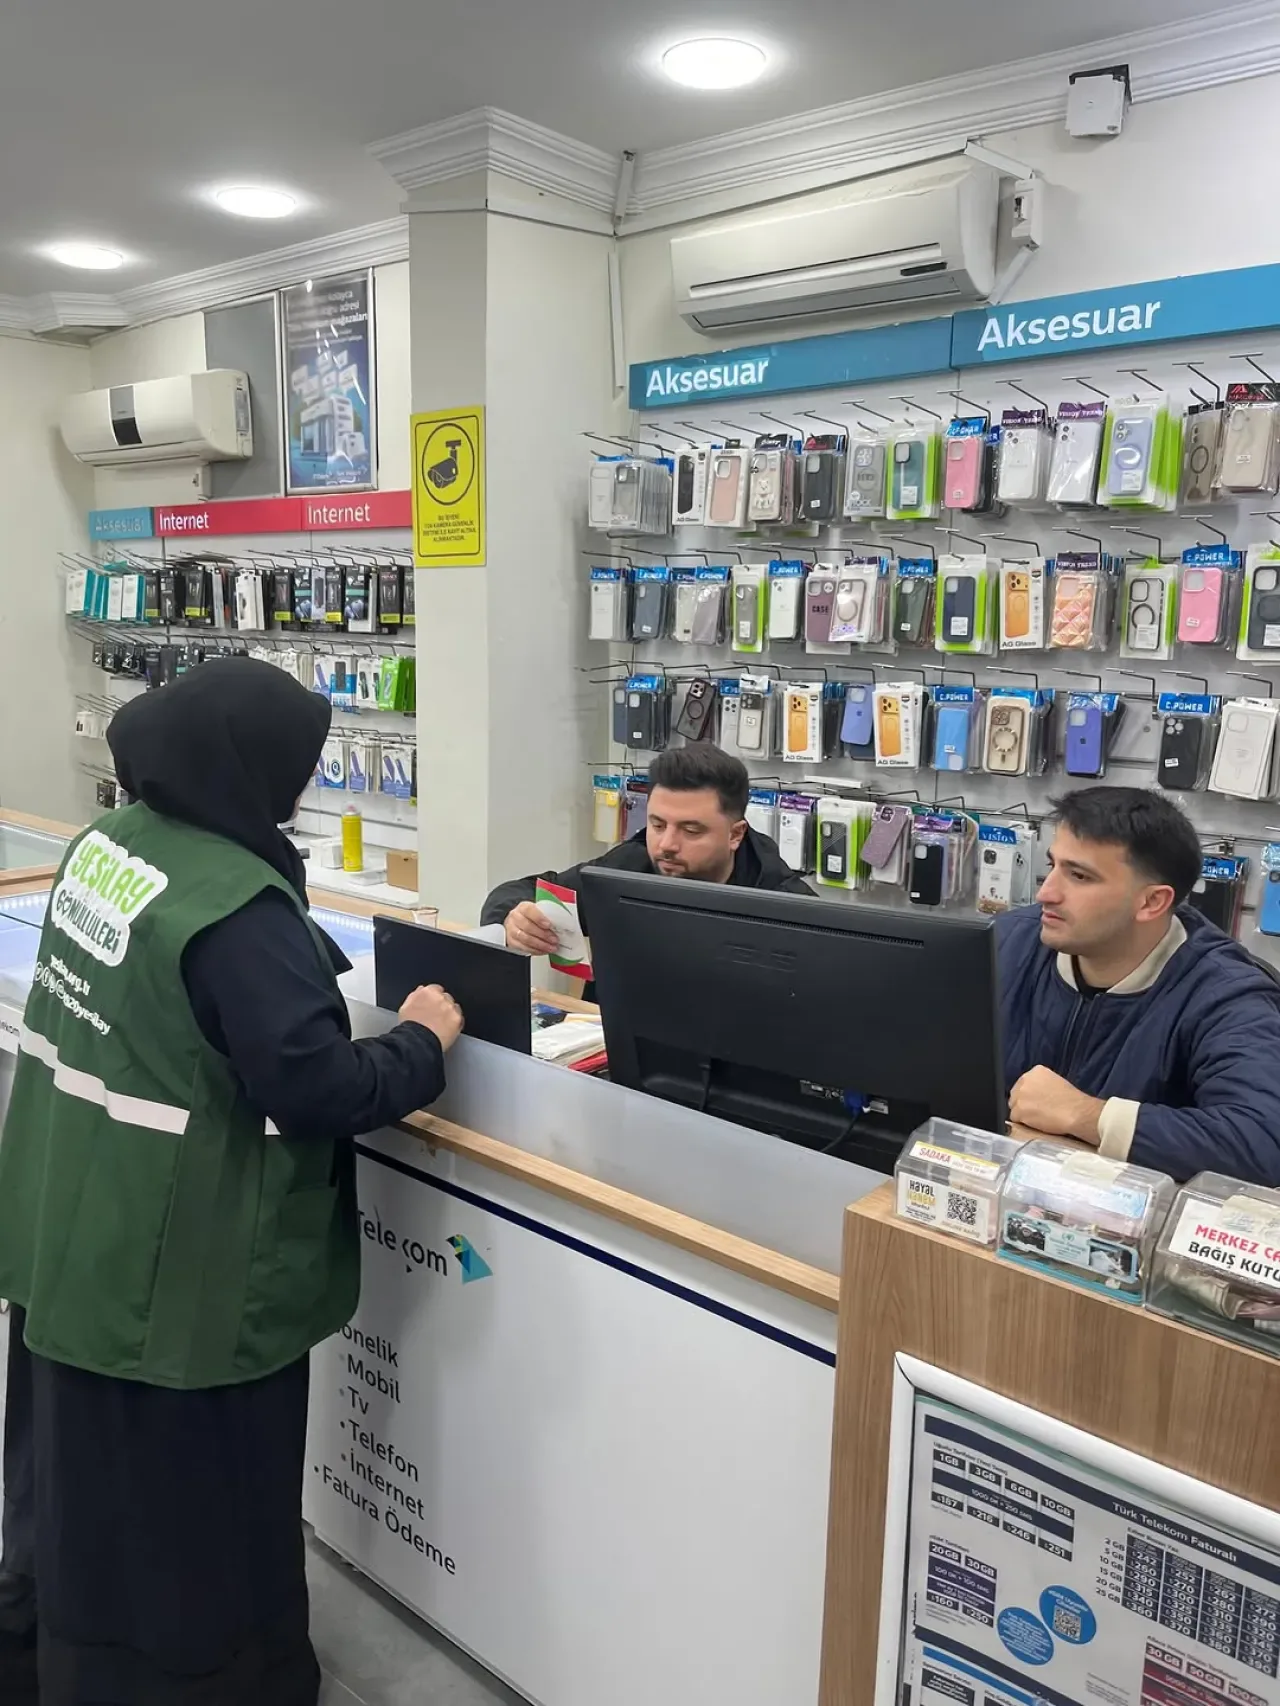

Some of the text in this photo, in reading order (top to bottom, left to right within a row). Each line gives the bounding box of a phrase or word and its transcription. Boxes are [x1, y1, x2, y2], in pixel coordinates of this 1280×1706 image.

[977, 300, 1161, 351] Aksesuar
[646, 359, 769, 397] Aksesuar
[160, 501, 209, 531] İnternet
[308, 503, 370, 526] İnternet
[812, 605, 829, 613] CASE
[919, 1147, 952, 1164] SADAKA
[1195, 1224, 1260, 1254] MERKEZ
[1188, 1241, 1236, 1269] BAĞIŞ
[347, 1353, 401, 1403] Mobil
[347, 1386, 369, 1415] Tv
[348, 1419, 419, 1482] Telefon
[350, 1448, 425, 1520] İnternet
[323, 1464, 456, 1575] Fatura Ödeme
[1112, 1502, 1138, 1520] Türk
[1141, 1513, 1189, 1543] Telekom
[1191, 1535, 1237, 1563] Faturalı
[1111, 1550, 1124, 1561] GB
[1112, 1541, 1125, 1552] GB
[1099, 1556, 1109, 1565] 10
[1111, 1560, 1124, 1572] GB
[1099, 1567, 1108, 1575] 15
[1109, 1571, 1123, 1583] GB
[1095, 1577, 1107, 1586] 20
[1109, 1582, 1122, 1593] GB
[1095, 1587, 1107, 1596] 25
[1108, 1592, 1121, 1604] GB
